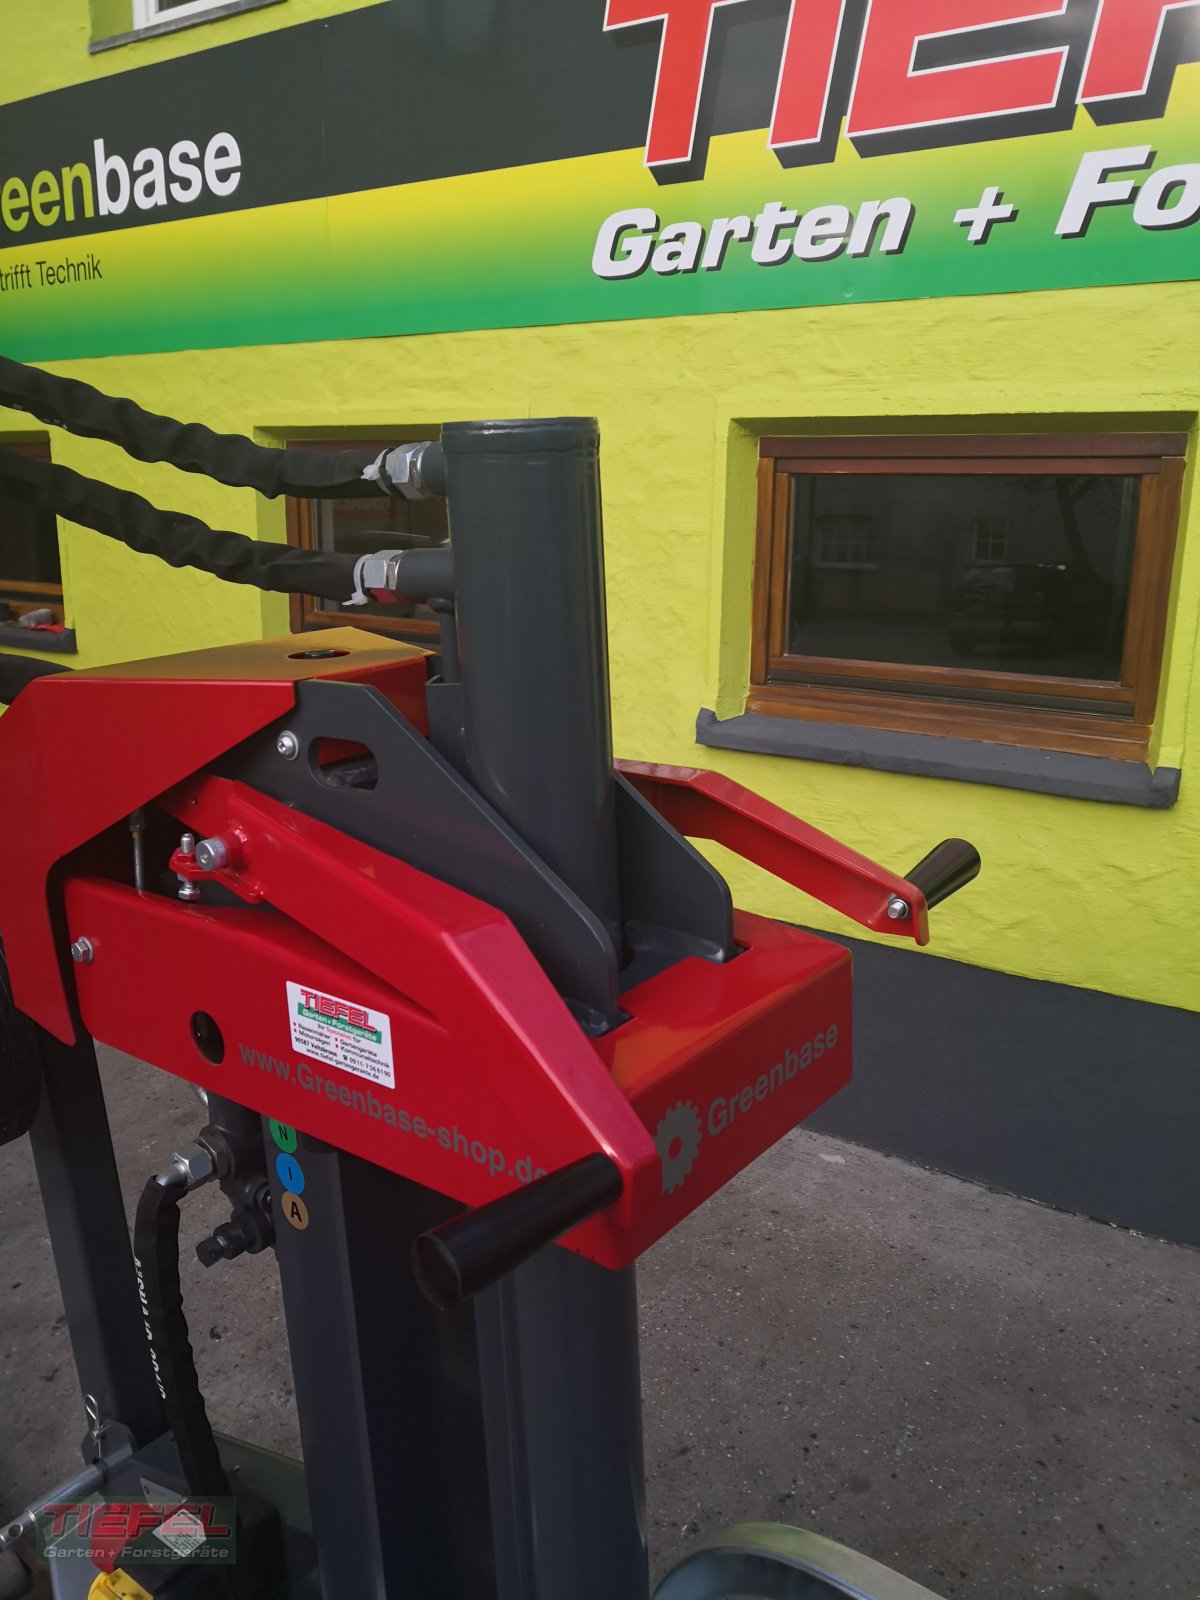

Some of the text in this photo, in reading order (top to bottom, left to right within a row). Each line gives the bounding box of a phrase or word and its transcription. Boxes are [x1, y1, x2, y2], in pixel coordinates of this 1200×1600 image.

[592, 197, 915, 279] Garten
[953, 187, 1016, 243] +
[36, 254, 102, 287] Technik
[300, 988, 377, 1034] TIEFEL
[707, 1024, 838, 1135] Greenbase
[278, 1125, 288, 1141] N
[290, 1201, 302, 1222] A
